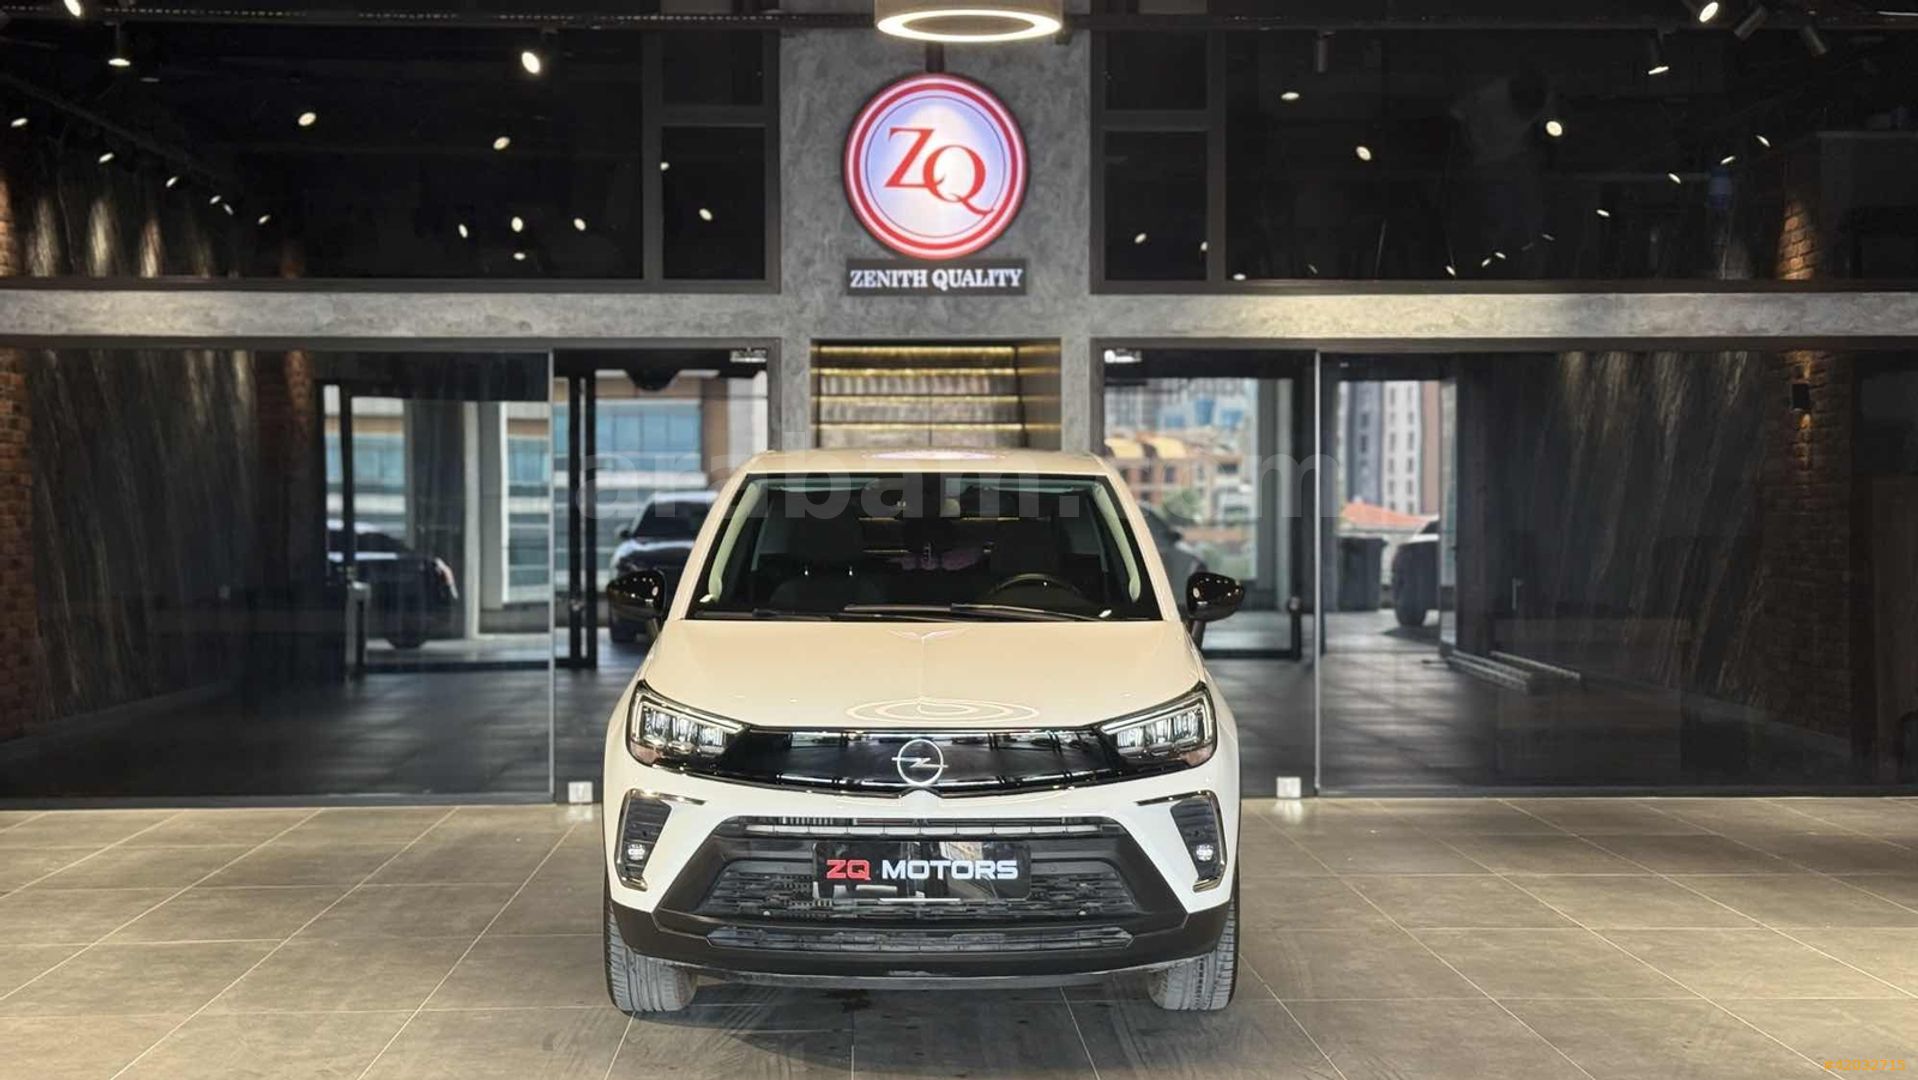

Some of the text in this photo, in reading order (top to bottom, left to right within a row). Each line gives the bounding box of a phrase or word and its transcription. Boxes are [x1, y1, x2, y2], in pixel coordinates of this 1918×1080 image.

[884, 127, 994, 217] ZQ
[850, 268, 1023, 291] ZENITH QUALITY
[826, 859, 1019, 881] ZQ MOTORS
